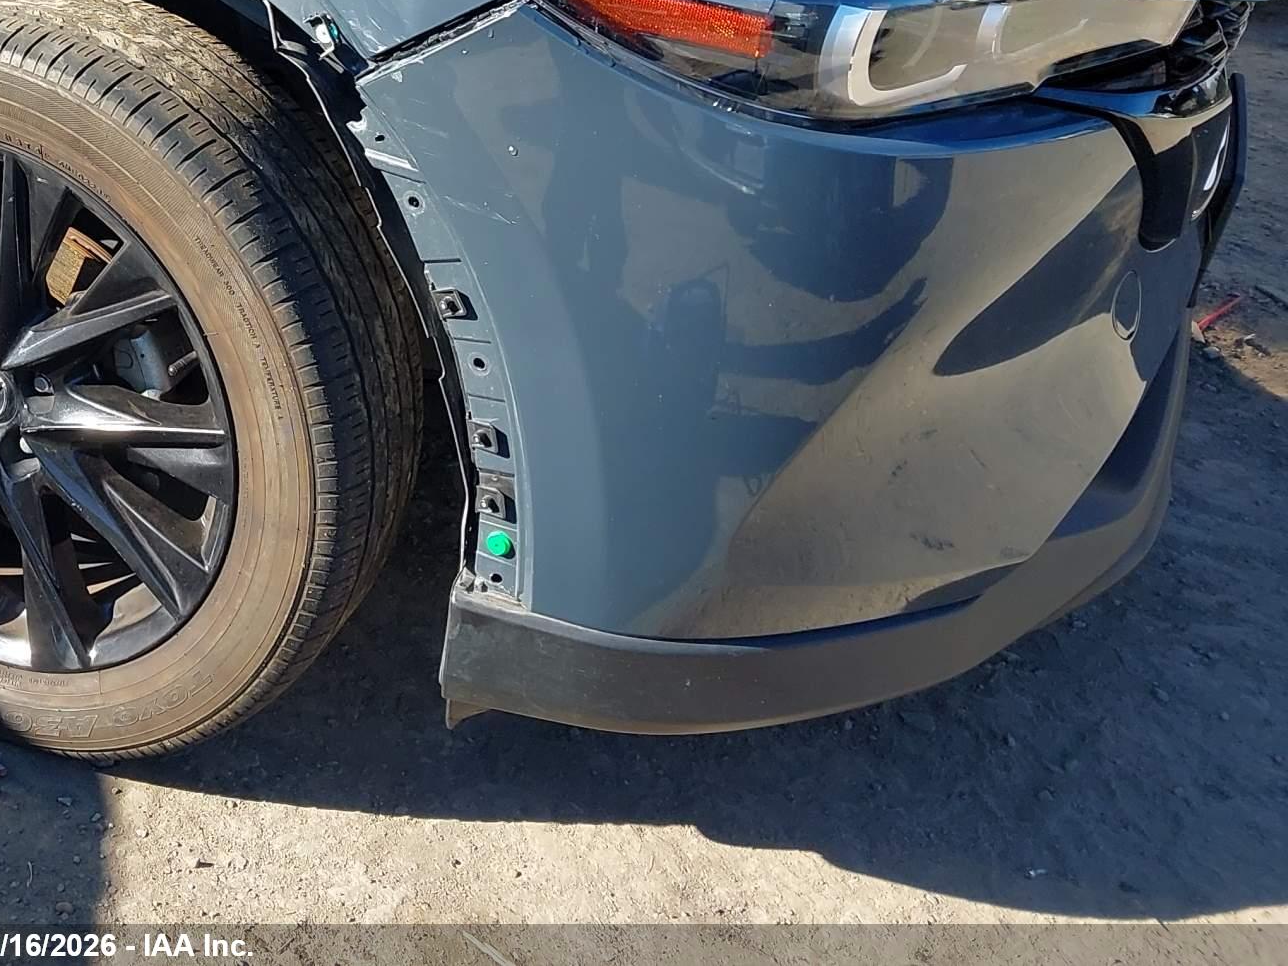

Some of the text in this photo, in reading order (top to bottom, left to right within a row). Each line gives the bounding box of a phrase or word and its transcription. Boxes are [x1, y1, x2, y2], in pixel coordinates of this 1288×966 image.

[194, 236, 225, 278] TREADWEAR
[236, 303, 258, 339] TRACTION
[111, 670, 213, 727] TOYO
